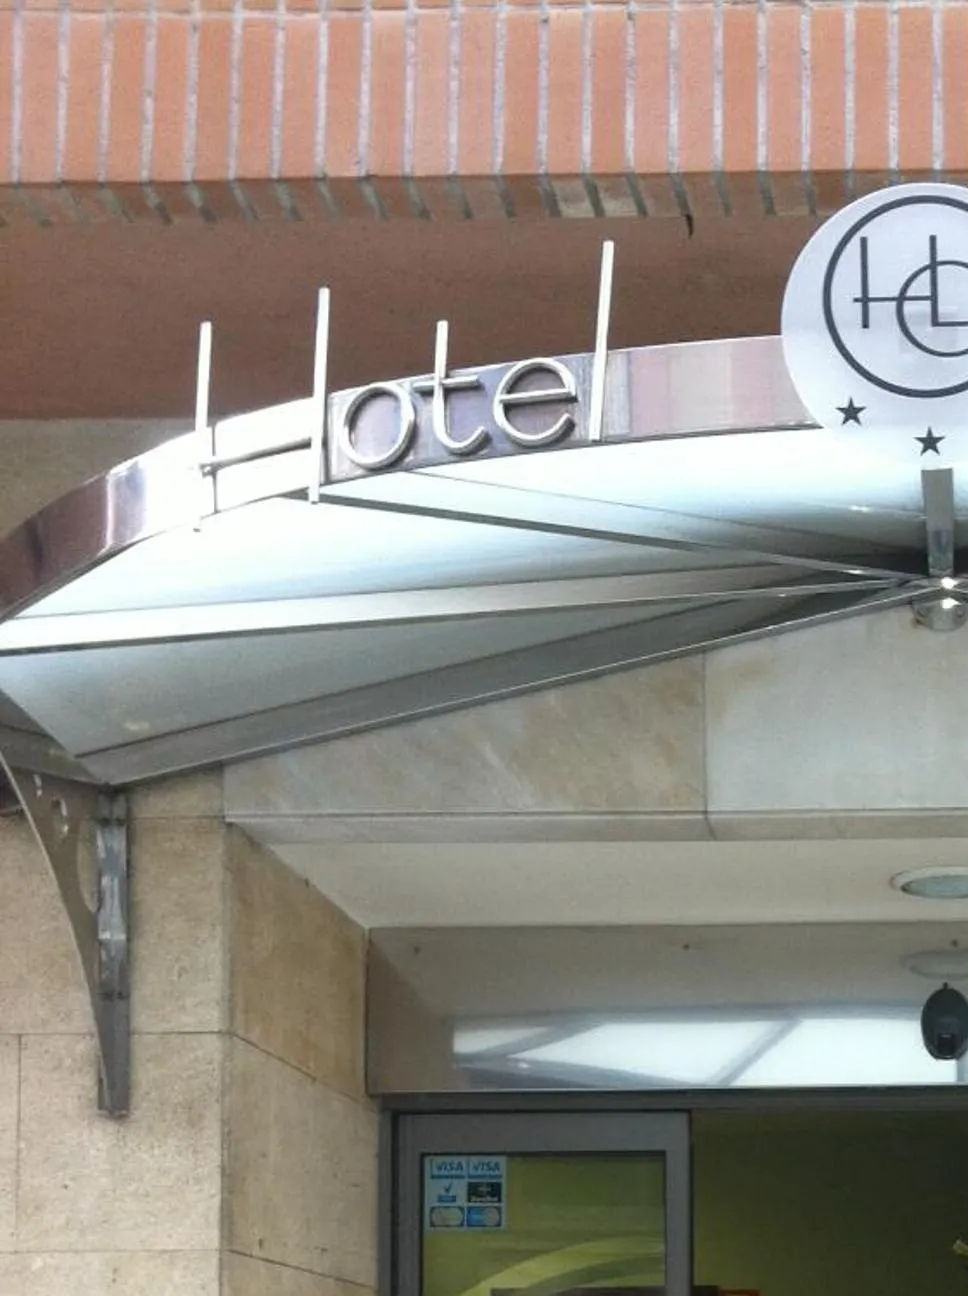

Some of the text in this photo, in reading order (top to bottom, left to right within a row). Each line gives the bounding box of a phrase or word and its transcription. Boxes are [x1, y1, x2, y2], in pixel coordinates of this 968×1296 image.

[194, 239, 615, 504] Hotel
[436, 1160, 464, 1172] VISA
[472, 1160, 501, 1172] VISA
